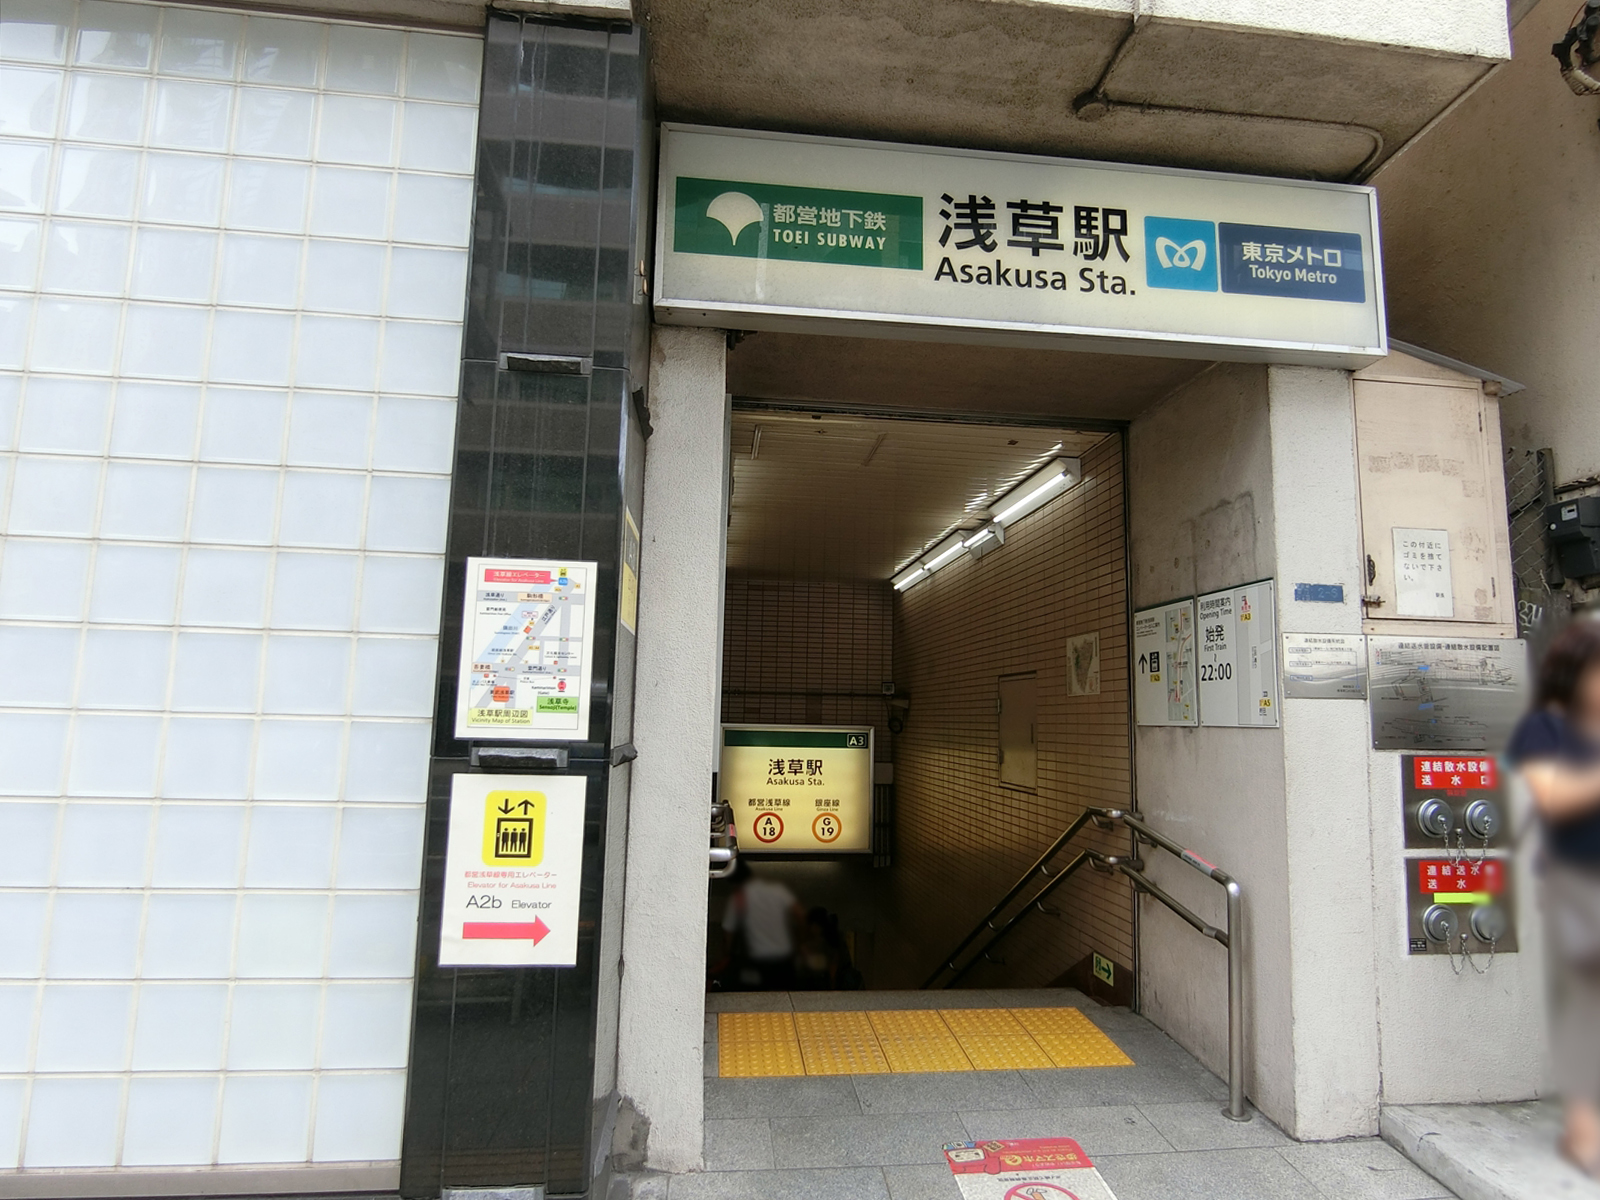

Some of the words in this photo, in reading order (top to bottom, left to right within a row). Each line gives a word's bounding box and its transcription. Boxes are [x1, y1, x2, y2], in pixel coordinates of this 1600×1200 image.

[773, 202, 886, 232] 都営地下鉄
[938, 193, 1131, 262] 浅草駅
[773, 228, 809, 245] TOEI
[817, 232, 886, 251] SUBWAY
[1241, 241, 1342, 268] 東京メトロ
[934, 256, 1066, 291] Asakusa
[1080, 267, 1136, 296] Sta.
[1249, 264, 1292, 284] Tokyo
[1295, 267, 1337, 285] Metro
[1402, 540, 1442, 549] この付近に
[1403, 551, 1442, 560] ゴミを捨て
[1403, 563, 1442, 572] ないで下さ
[1200, 597, 1231, 611] 利用時間案内
[1199, 610, 1220, 621] Opening
[1221, 608, 1232, 616] Time
[1205, 624, 1225, 643] 始発
[1203, 644, 1214, 652] First
[1215, 642, 1227, 651] Train
[1200, 662, 1232, 681] 22:00
[477, 709, 529, 718] 浅草駅周辺図
[849, 736, 864, 746] A3
[768, 758, 823, 776] 浅草駅
[766, 777, 805, 786] Asakusa
[807, 777, 825, 786] Sta.
[748, 798, 790, 807] 都営浅草線
[815, 798, 840, 807] 銀座線
[764, 817, 773, 826] A
[822, 817, 831, 826] G
[763, 827, 776, 836] 18
[821, 827, 835, 836] 19
[1427, 864, 1494, 876] 連結送水
[467, 881, 496, 889] Elevator
[466, 894, 502, 909] A2b
[511, 899, 552, 909] Elevator
